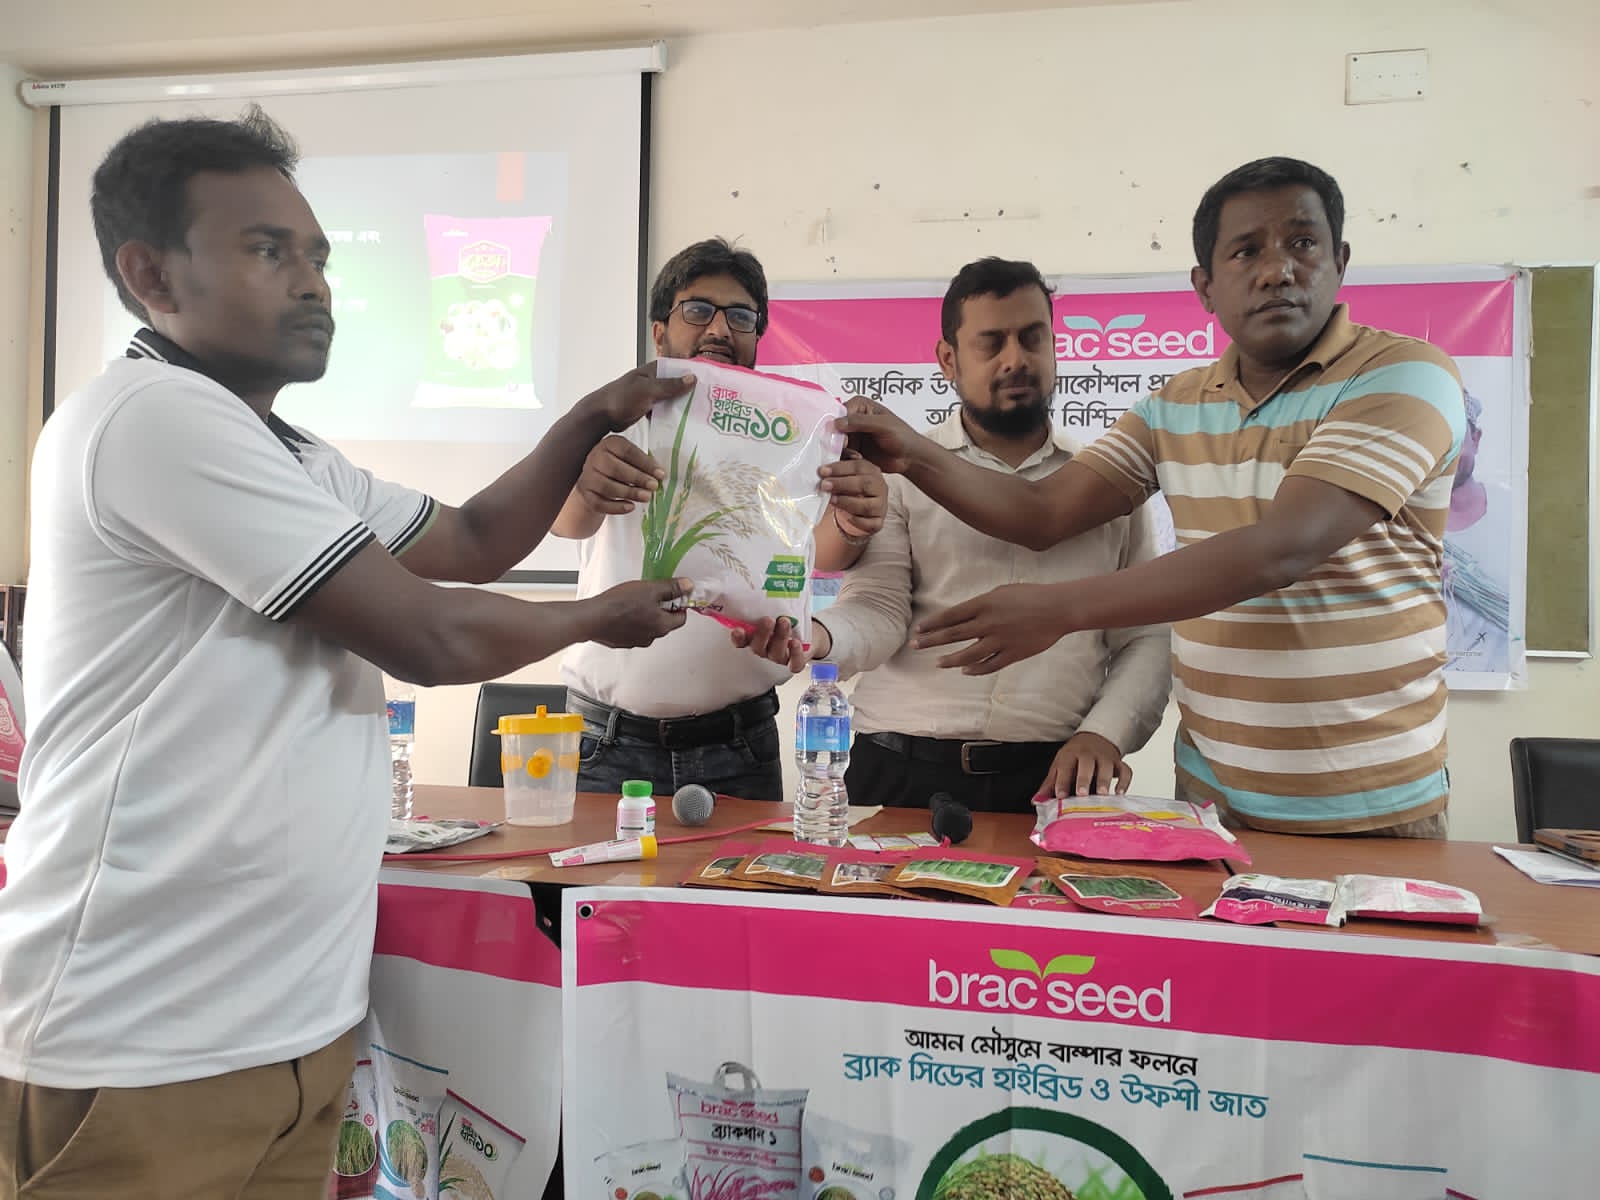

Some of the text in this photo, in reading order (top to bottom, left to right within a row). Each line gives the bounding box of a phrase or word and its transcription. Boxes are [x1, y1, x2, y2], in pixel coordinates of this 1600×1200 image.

[1055, 322, 1215, 359] ac seed
[840, 370, 925, 402] আধুনিক
[1055, 364, 1142, 395] াকৌশল
[1062, 401, 1130, 429] নিশ্চি
[928, 958, 1171, 1023] brac seed
[904, 1026, 1198, 1076] আমন মৌসুমে বাম্পার ফলনে
[843, 1052, 1270, 1118] ব্র্যাক সিডের হাইব্রিড ও উফশী জাত
